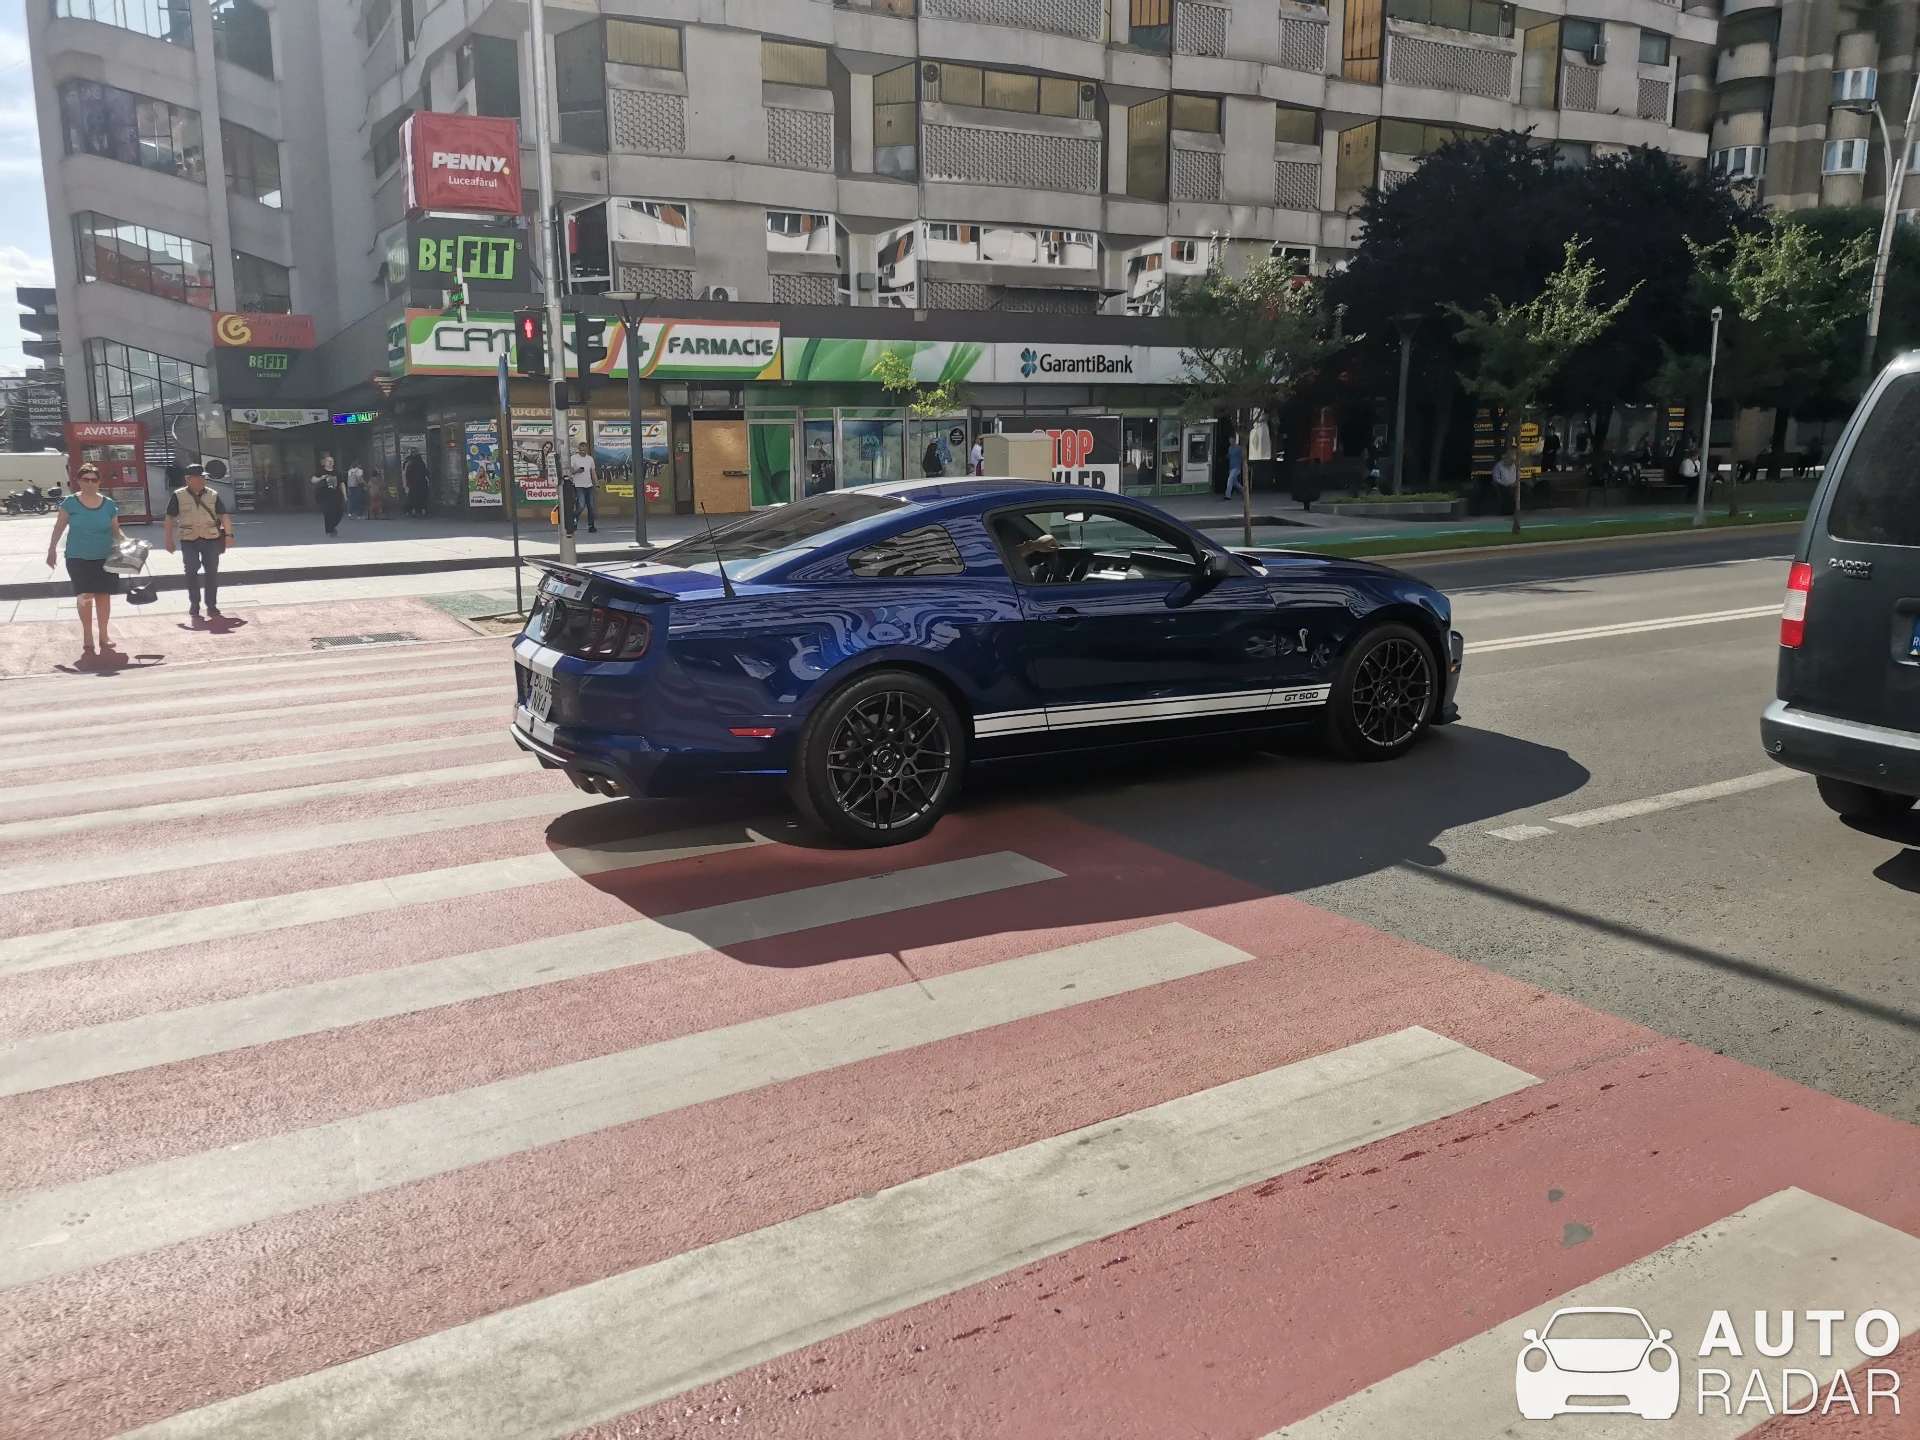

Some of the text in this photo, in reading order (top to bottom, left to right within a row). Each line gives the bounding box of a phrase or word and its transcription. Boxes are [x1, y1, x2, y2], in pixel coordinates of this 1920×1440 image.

[448, 176, 498, 188] Luceafărul
[668, 336, 774, 357] FARMACIE
[1039, 353, 1134, 375] GarantiBank
[84, 427, 127, 435] AVATAR
[1828, 558, 1872, 569] CADDY
